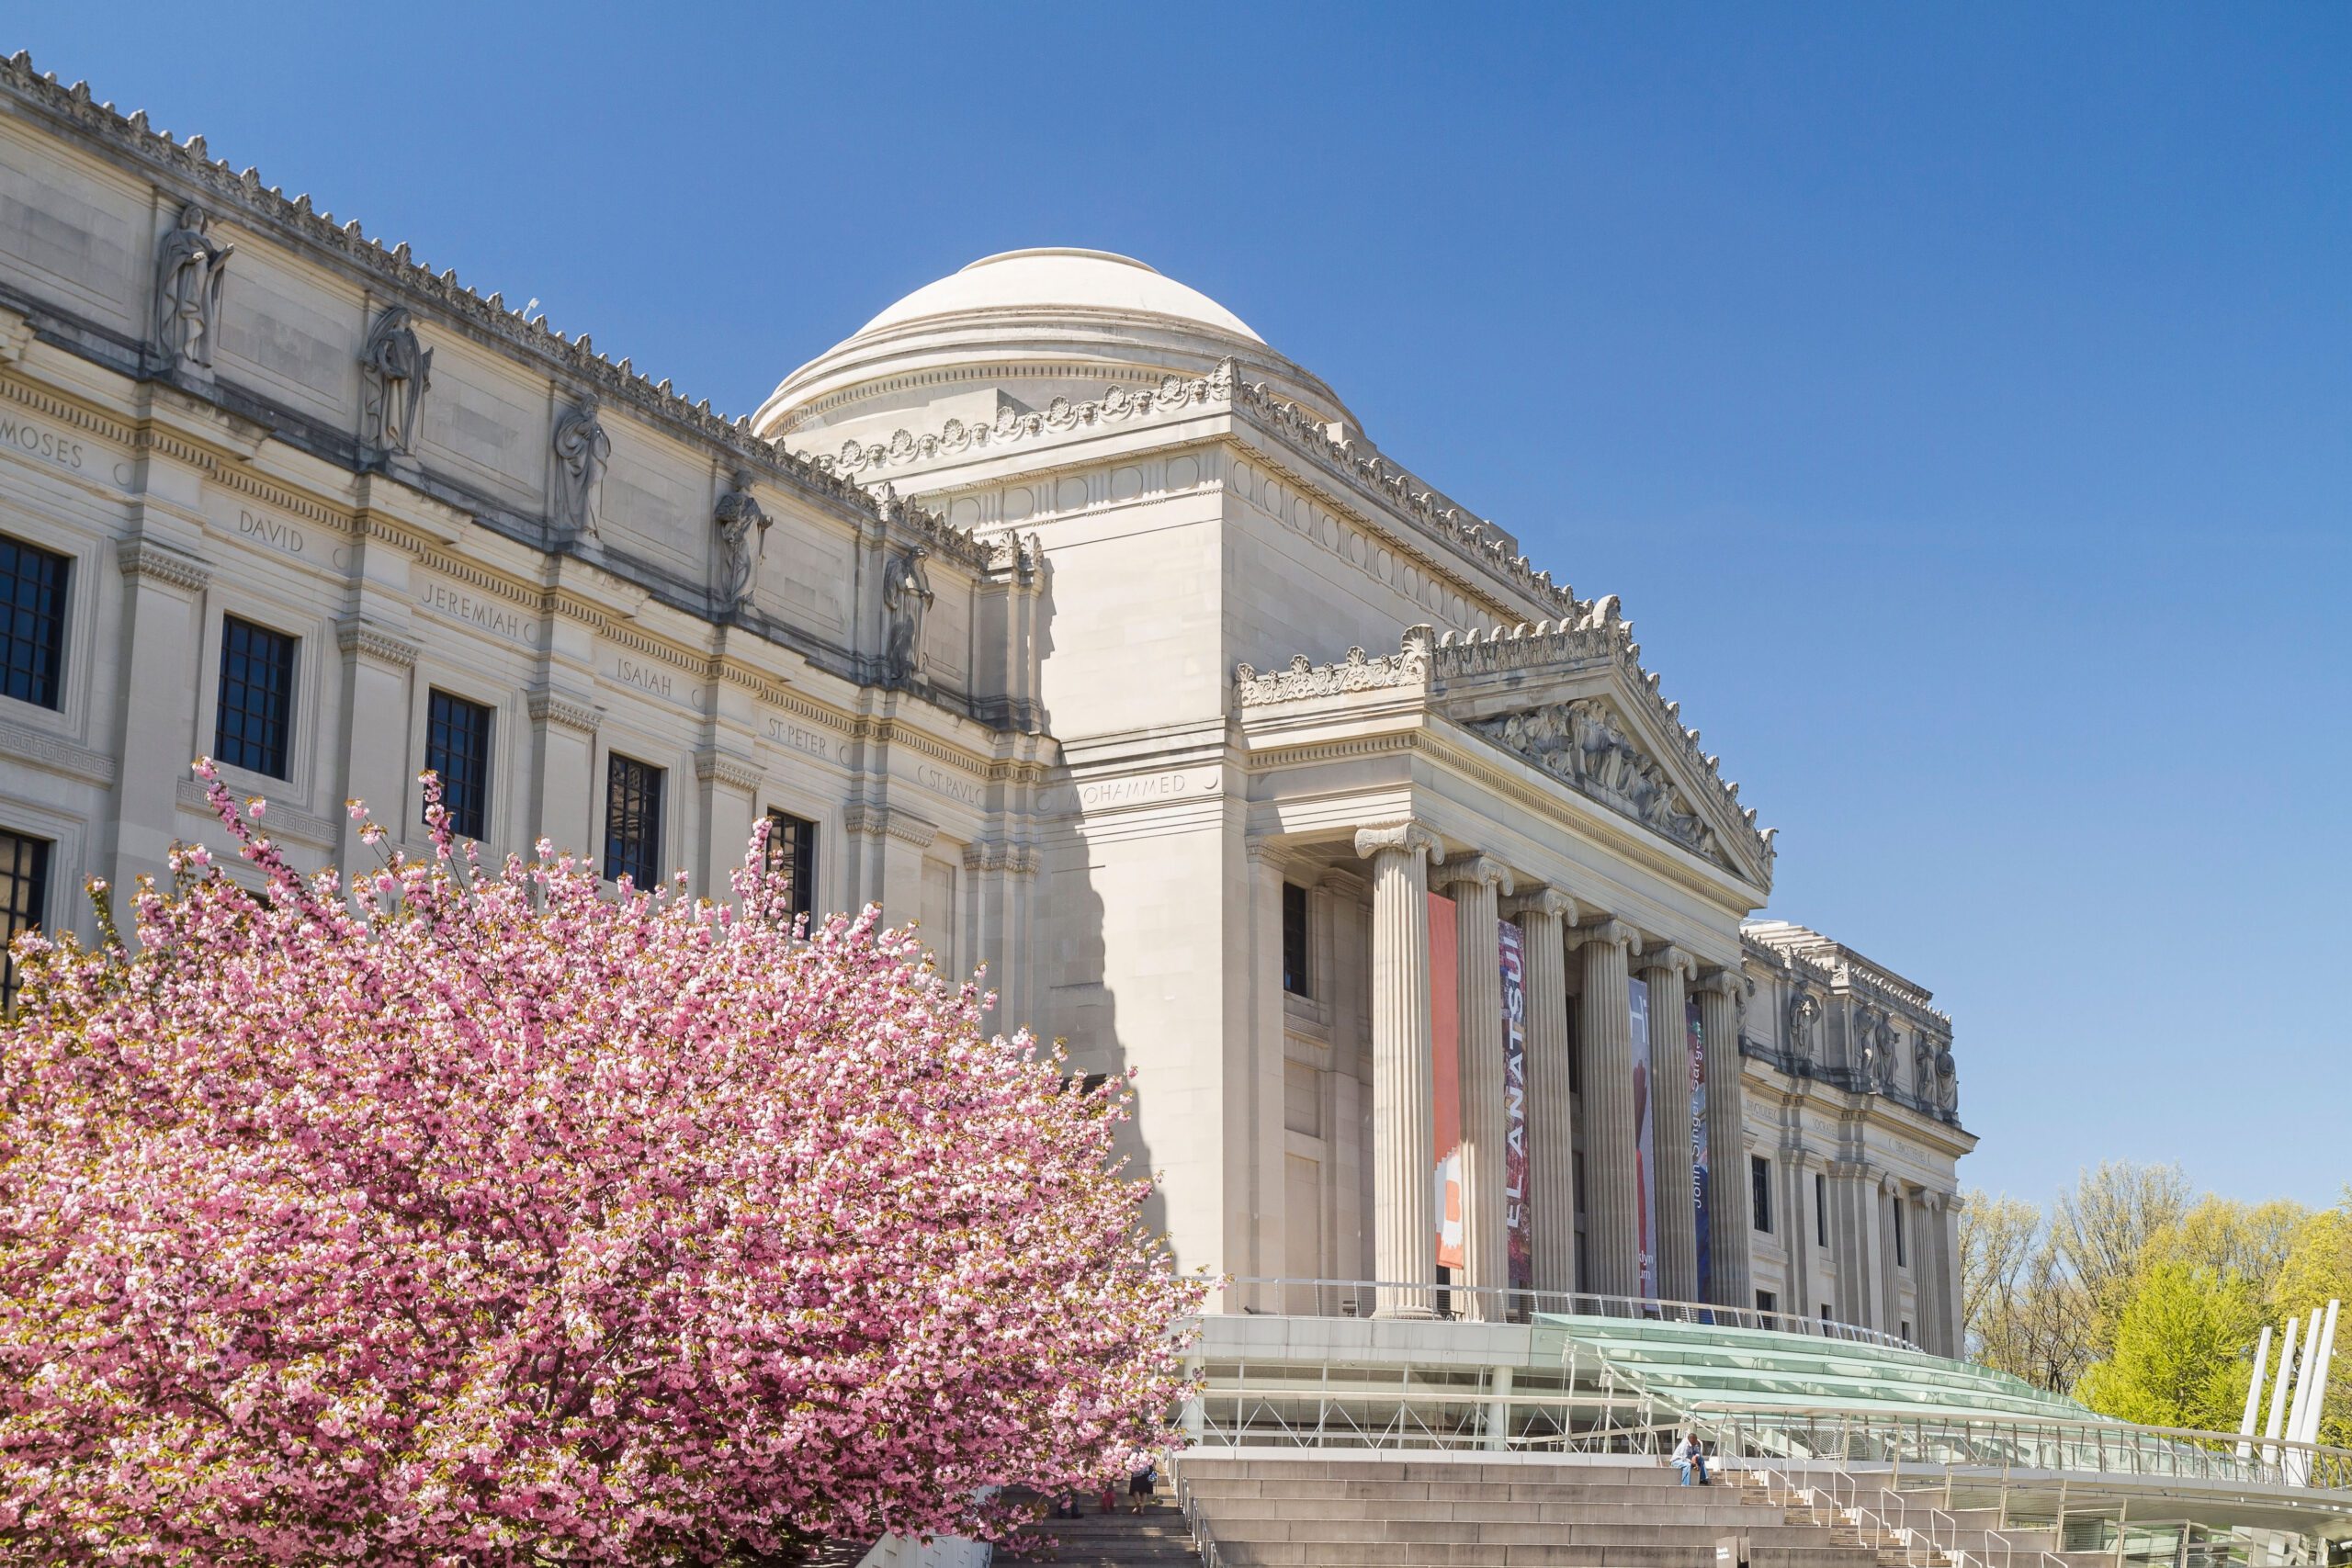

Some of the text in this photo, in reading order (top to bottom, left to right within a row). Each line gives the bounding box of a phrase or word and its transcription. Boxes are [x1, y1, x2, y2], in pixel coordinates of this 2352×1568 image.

[0, 418, 84, 468] MOSES
[240, 510, 304, 553] DAVID
[422, 584, 518, 637] JEREMIAH
[616, 658, 672, 697] ISAIAH
[1068, 774, 1186, 807] MOHAMMED
[1630, 995, 1650, 1046] Hi
[1503, 935, 1524, 1228] EL ANATSUI
[1691, 1098, 1701, 1157] Singer
[1692, 1162, 1702, 1209] John
